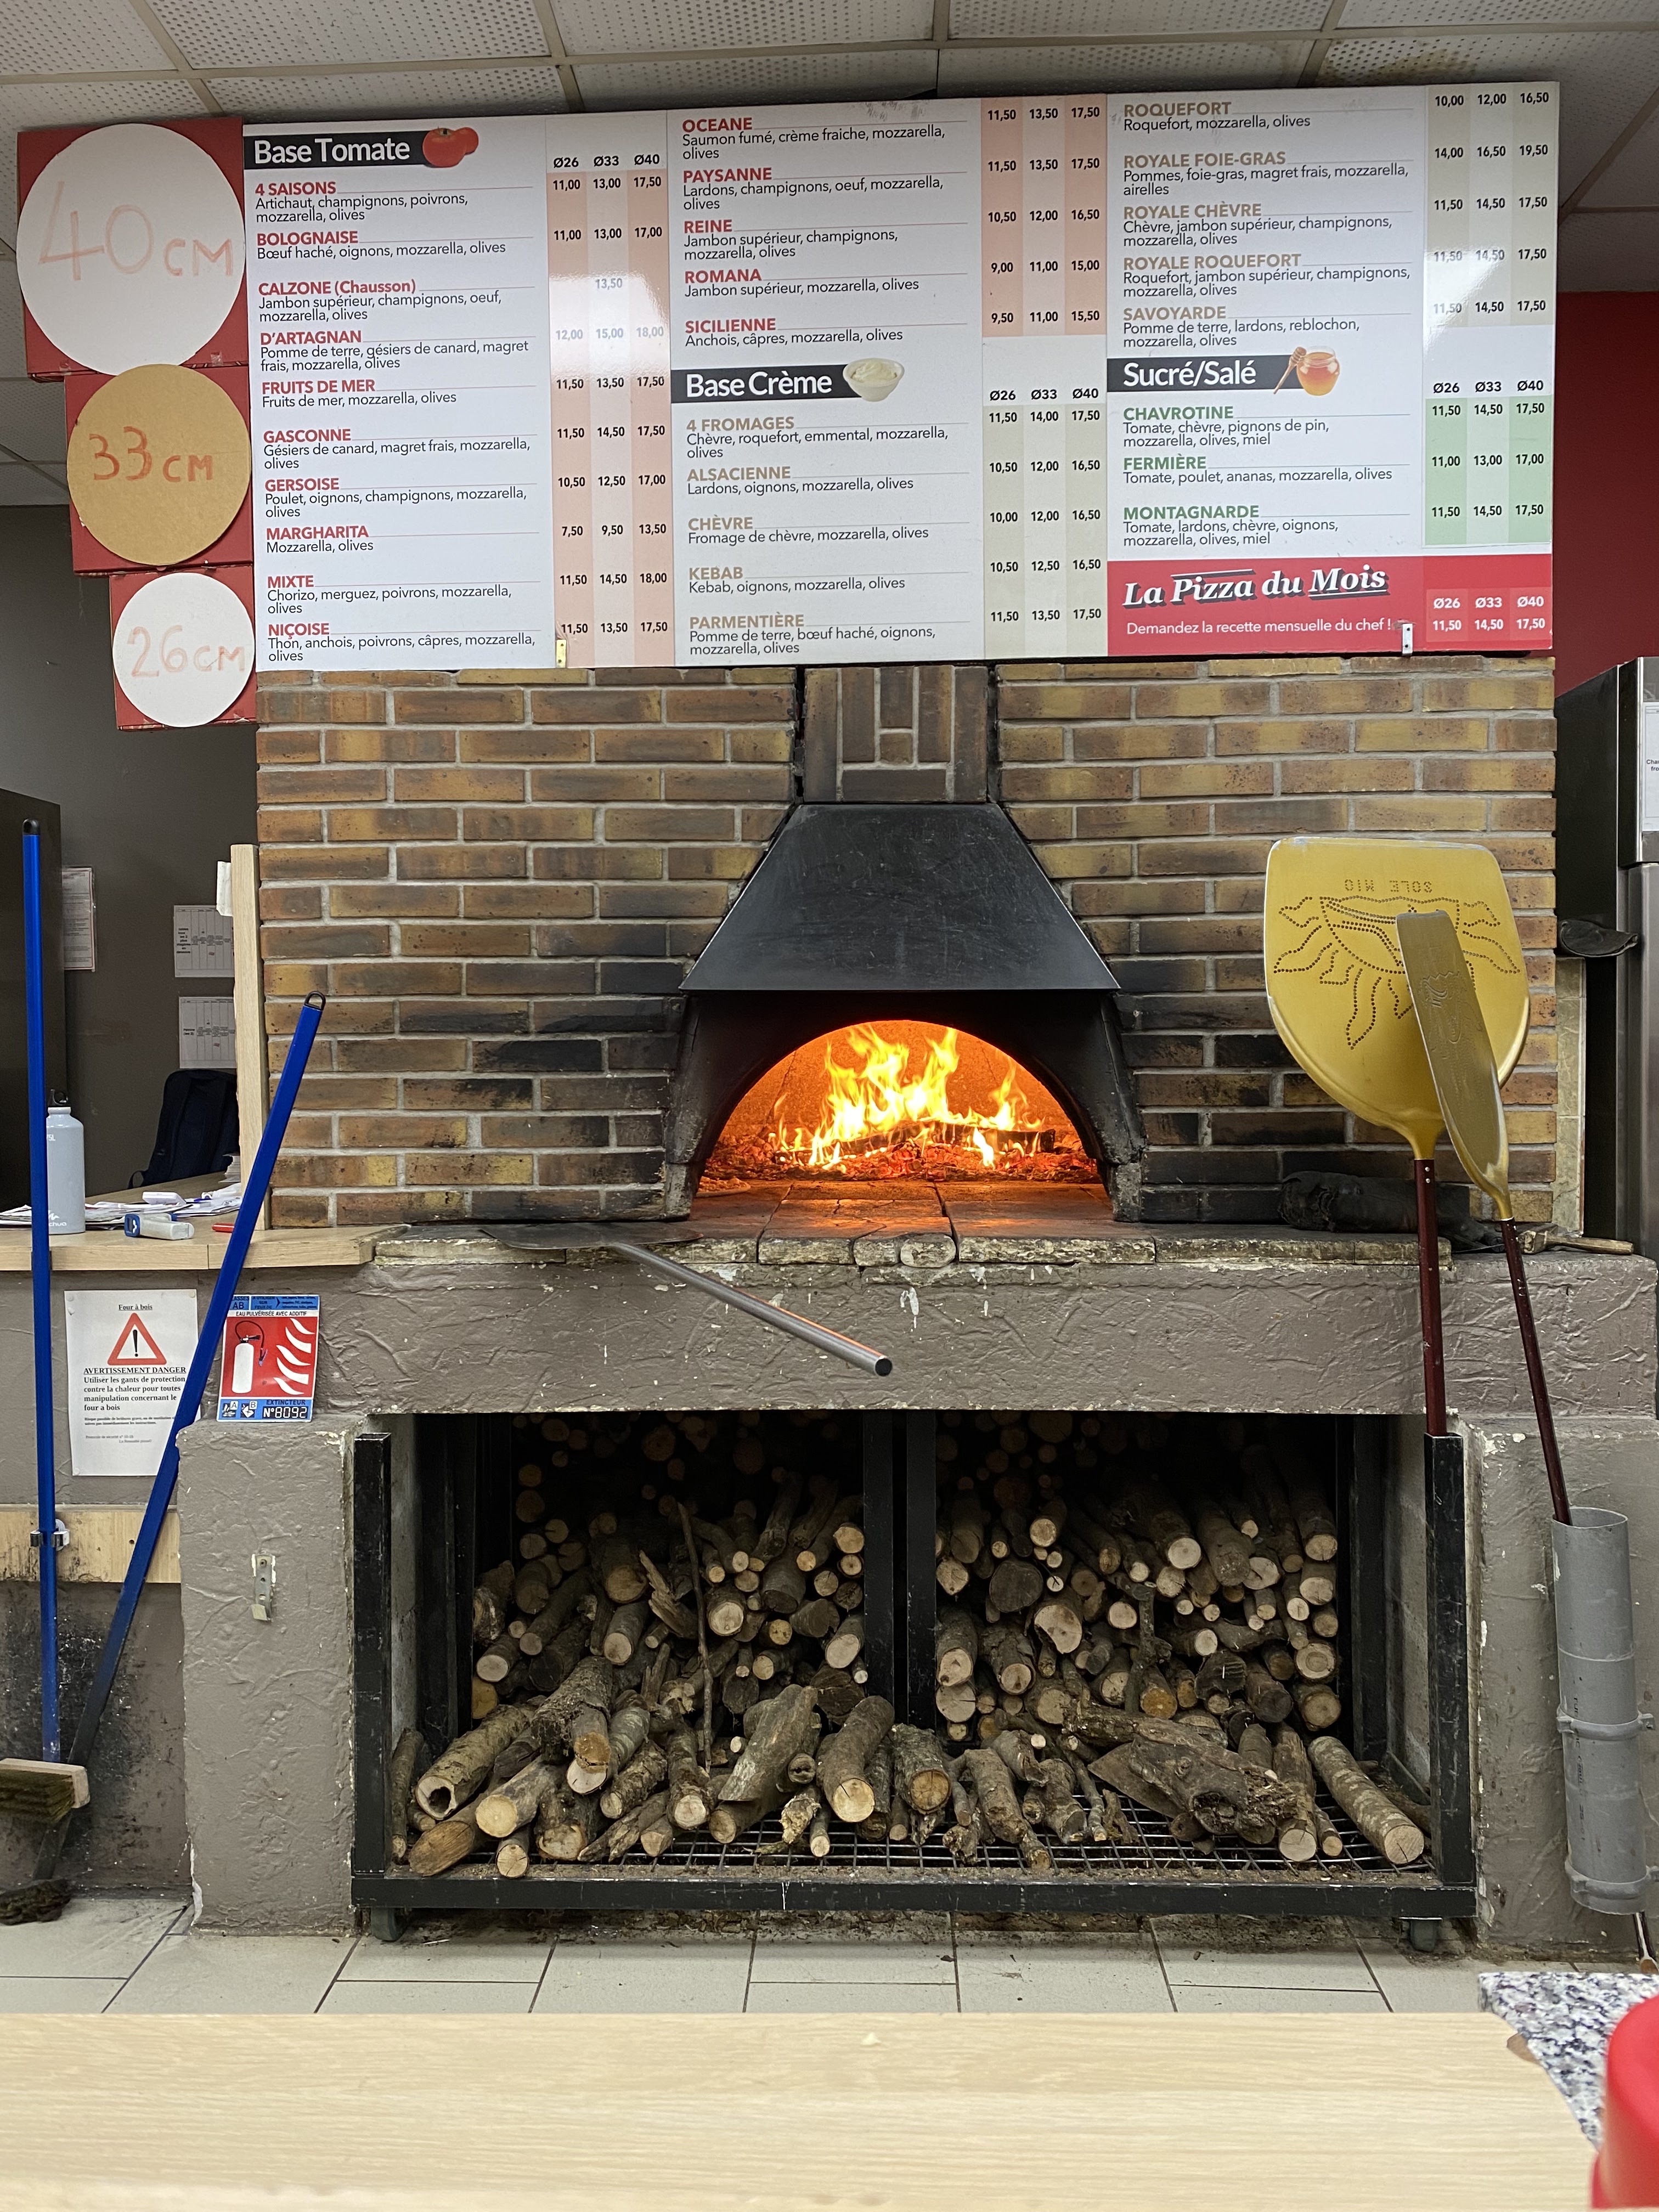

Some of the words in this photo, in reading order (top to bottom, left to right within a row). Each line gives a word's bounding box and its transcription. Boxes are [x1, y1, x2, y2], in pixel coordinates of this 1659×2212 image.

[1124, 101, 1231, 117] ROQUEFORT
[682, 117, 752, 132] OCEANE
[682, 134, 735, 146] Saumon
[738, 131, 775, 144] fumé,
[778, 132, 819, 142] crème
[822, 128, 868, 140] fraiche,
[872, 126, 945, 138] mozzarella,
[255, 140, 312, 163] Base
[314, 138, 410, 162] Tomate
[682, 147, 719, 159] olives
[1124, 154, 1189, 168] ROYALE
[1195, 151, 1285, 166] FOIE-GRAS
[684, 167, 771, 183] PAYSANNE
[1124, 170, 1183, 182] Pommes,
[1186, 167, 1246, 183] foie-gras,
[1251, 167, 1298, 182] magret
[1301, 165, 1330, 178] frais,
[1335, 163, 1408, 177] mozzarella,
[255, 183, 264, 196] 4
[268, 181, 336, 195] SAISONS
[553, 179, 580, 191] 11,00
[593, 178, 620, 189] 13,00
[634, 176, 661, 188] 17,50
[1124, 182, 1169, 195] airelles
[255, 196, 314, 211] Artichaut,
[318, 195, 407, 210] champignons,
[410, 195, 467, 208] poivrons,
[1124, 205, 1189, 219] ROYALE
[1194, 203, 1261, 218] CHÈVRE
[256, 209, 325, 222] mozzarella,
[329, 208, 364, 221] olives
[684, 219, 732, 233] REINE
[257, 230, 358, 246] BOLOGNAISE
[257, 246, 292, 259] Bœuf
[295, 245, 336, 259] haché,
[339, 245, 393, 259] oignons,
[397, 242, 466, 255] mozzarella,
[470, 241, 505, 253] olives
[1124, 256, 1189, 270] ROYALE
[1194, 253, 1301, 268] ROQUEFORT
[685, 268, 762, 284] ROMANA
[258, 281, 331, 295] CALZONE
[335, 279, 415, 296] (Chausson)
[1123, 306, 1226, 320] SAVOYARDE
[685, 318, 776, 333] SICILIENNE
[1123, 360, 1256, 386] Sucré/Salé
[262, 381, 313, 394] FRUITS
[317, 380, 337, 393] DE
[342, 379, 375, 392] MER
[687, 374, 744, 397] Base
[748, 370, 832, 395] Crème
[1124, 406, 1235, 420] CHAVROTINE
[686, 419, 697, 432] 4
[702, 416, 794, 431] FROMAGES
[263, 428, 351, 443] GASCONNE
[1124, 454, 1206, 470] FERMIÈRE
[687, 466, 791, 481] ALSACIENNE
[1123, 472, 1175, 484] Tomate,
[1178, 470, 1223, 486] poulet,
[1227, 473, 1275, 483] ananas,
[1279, 468, 1351, 481] mozzarella,
[1355, 467, 1392, 479] olives
[265, 478, 339, 492] GERSOISE
[688, 482, 741, 495] Lardons,
[744, 481, 798, 496] oignons,
[803, 478, 873, 491] mozzarella,
[877, 477, 913, 489] olives
[1124, 505, 1259, 520] MONTAGNARDE
[1432, 506, 1460, 518] 11,50
[1474, 505, 1502, 517] 14,50
[1515, 504, 1543, 516] 17,50
[688, 514, 753, 531] CHÈVRE
[267, 525, 369, 540] MARGHARITA
[689, 566, 743, 580] KEBAB
[268, 575, 314, 588] MIXTE
[1122, 582, 1163, 605] La
[1170, 575, 1254, 602] Pizza
[1261, 570, 1302, 595] du
[1307, 564, 1386, 591] Mois
[690, 611, 804, 629] PARMENTIÈRE
[1127, 621, 1199, 634] Demandez
[1202, 620, 1212, 633] la
[1216, 622, 1261, 632] recette
[1265, 618, 1331, 631] mensuelle
[1335, 618, 1352, 630] du
[1356, 617, 1385, 630] chef
[1432, 619, 1462, 631] 11,50
[1474, 618, 1503, 631] 14,50
[1516, 618, 1545, 630] 17,50
[268, 623, 329, 639] NIÇOISE
[84, 1395, 128, 1403] manipulation
